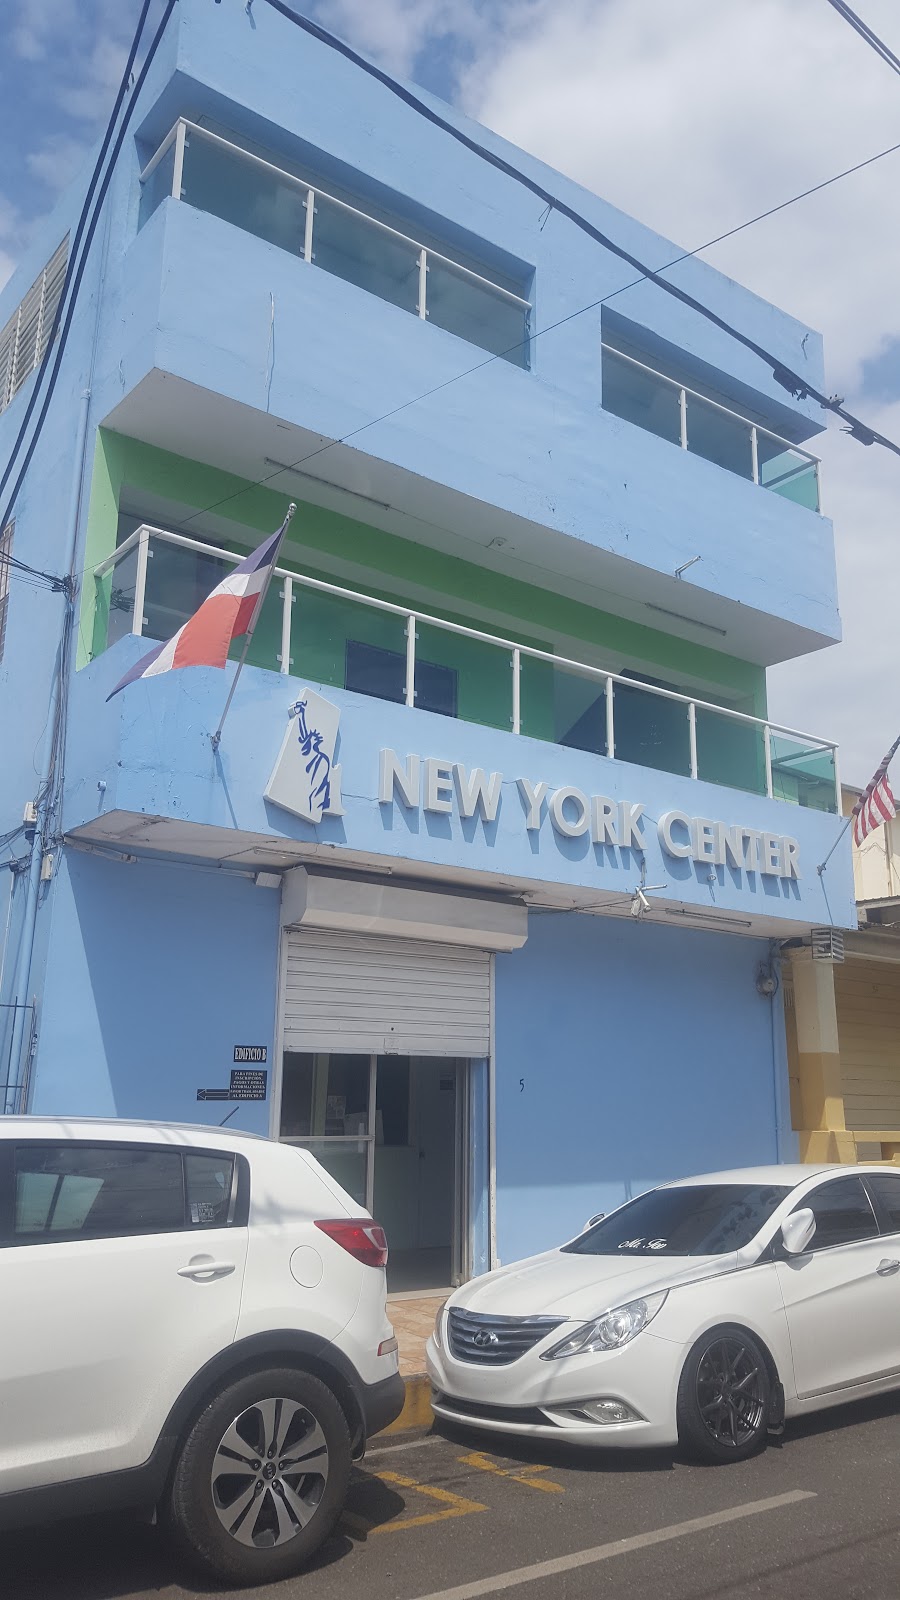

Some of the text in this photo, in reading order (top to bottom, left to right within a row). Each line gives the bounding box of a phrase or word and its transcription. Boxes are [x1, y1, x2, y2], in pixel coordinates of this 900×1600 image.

[379, 747, 802, 880] NEW YORK CENTER
[234, 1047, 266, 1061] EDIFICIO B
